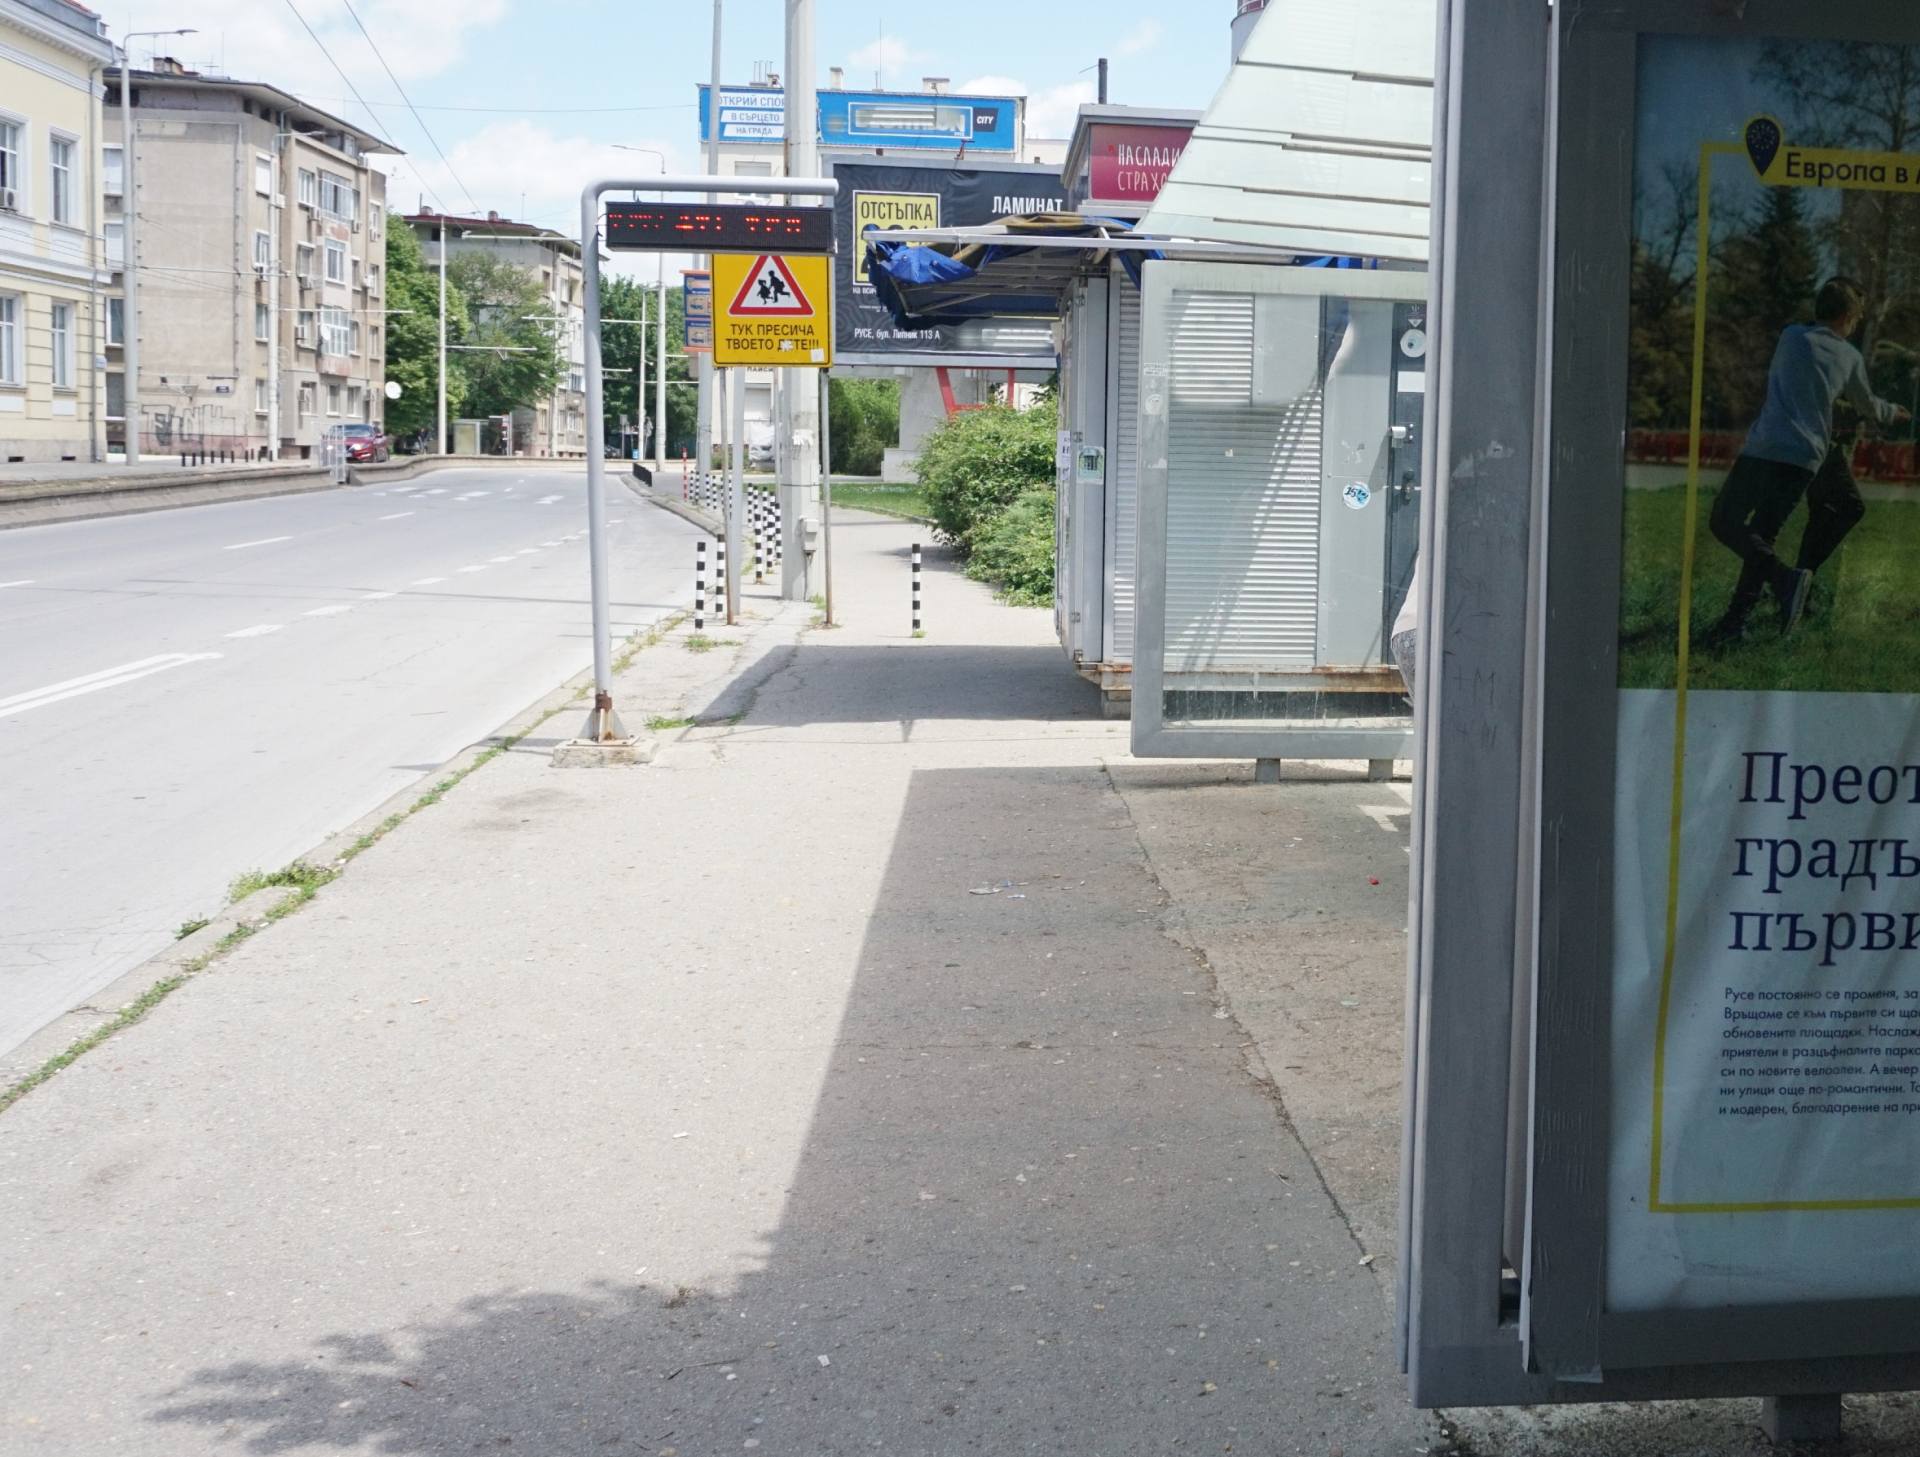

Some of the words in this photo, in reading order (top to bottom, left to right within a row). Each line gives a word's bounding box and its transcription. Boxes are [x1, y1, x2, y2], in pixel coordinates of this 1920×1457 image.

[740, 113, 780, 123] СЪРЦЕТО
[976, 116, 994, 125] CITY
[748, 128, 772, 136] ГРАДА
[1786, 152, 1885, 187] Европа
[1896, 167, 1908, 183] в
[861, 201, 933, 221] ОТСТЪПКА
[992, 196, 1063, 214] ЛАМИНАТ
[730, 324, 753, 335] ТУК
[757, 324, 814, 336] ПРЕСИЧА
[854, 328, 874, 339] РУСЕ,
[876, 329, 890, 340] бул.
[892, 329, 918, 339] Липник
[920, 330, 933, 339] 113
[726, 338, 774, 350] ТВОЕТО
[1732, 838, 1920, 894] градъ
[1725, 988, 1754, 1003] Русе
[1759, 991, 1821, 1000] постоянно
[1826, 991, 1840, 999] се
[1844, 990, 1898, 1003] променя,
[1903, 990, 1918, 999] за
[1724, 1007, 1783, 1022] Връщаме
[1787, 1010, 1800, 1019] се
[1803, 1010, 1826, 1018] към
[1830, 1009, 1876, 1022] първите
[1881, 1009, 1895, 1017] си
[1723, 1026, 1796, 1039] обновените
[1800, 1028, 1864, 1039] площадки.
[1722, 1048, 1778, 1060] приятели
[1792, 1046, 1881, 1059] разцъфналите
[1721, 1068, 1735, 1076] си
[1740, 1068, 1754, 1076] по
[1758, 1067, 1800, 1076] новите
[1804, 1066, 1865, 1076] велоалеи.
[1869, 1063, 1879, 1074] А
[1883, 1065, 1918, 1077] вечер
[1720, 1087, 1734, 1095] ни
[1739, 1087, 1774, 1098] улици
[1779, 1086, 1804, 1096] още
[1809, 1083, 1906, 1097] по-романтични.
[1730, 1105, 1787, 1117] модерен,
[1792, 1102, 1880, 1116] благодарение
[1884, 1104, 1898, 1112] на
